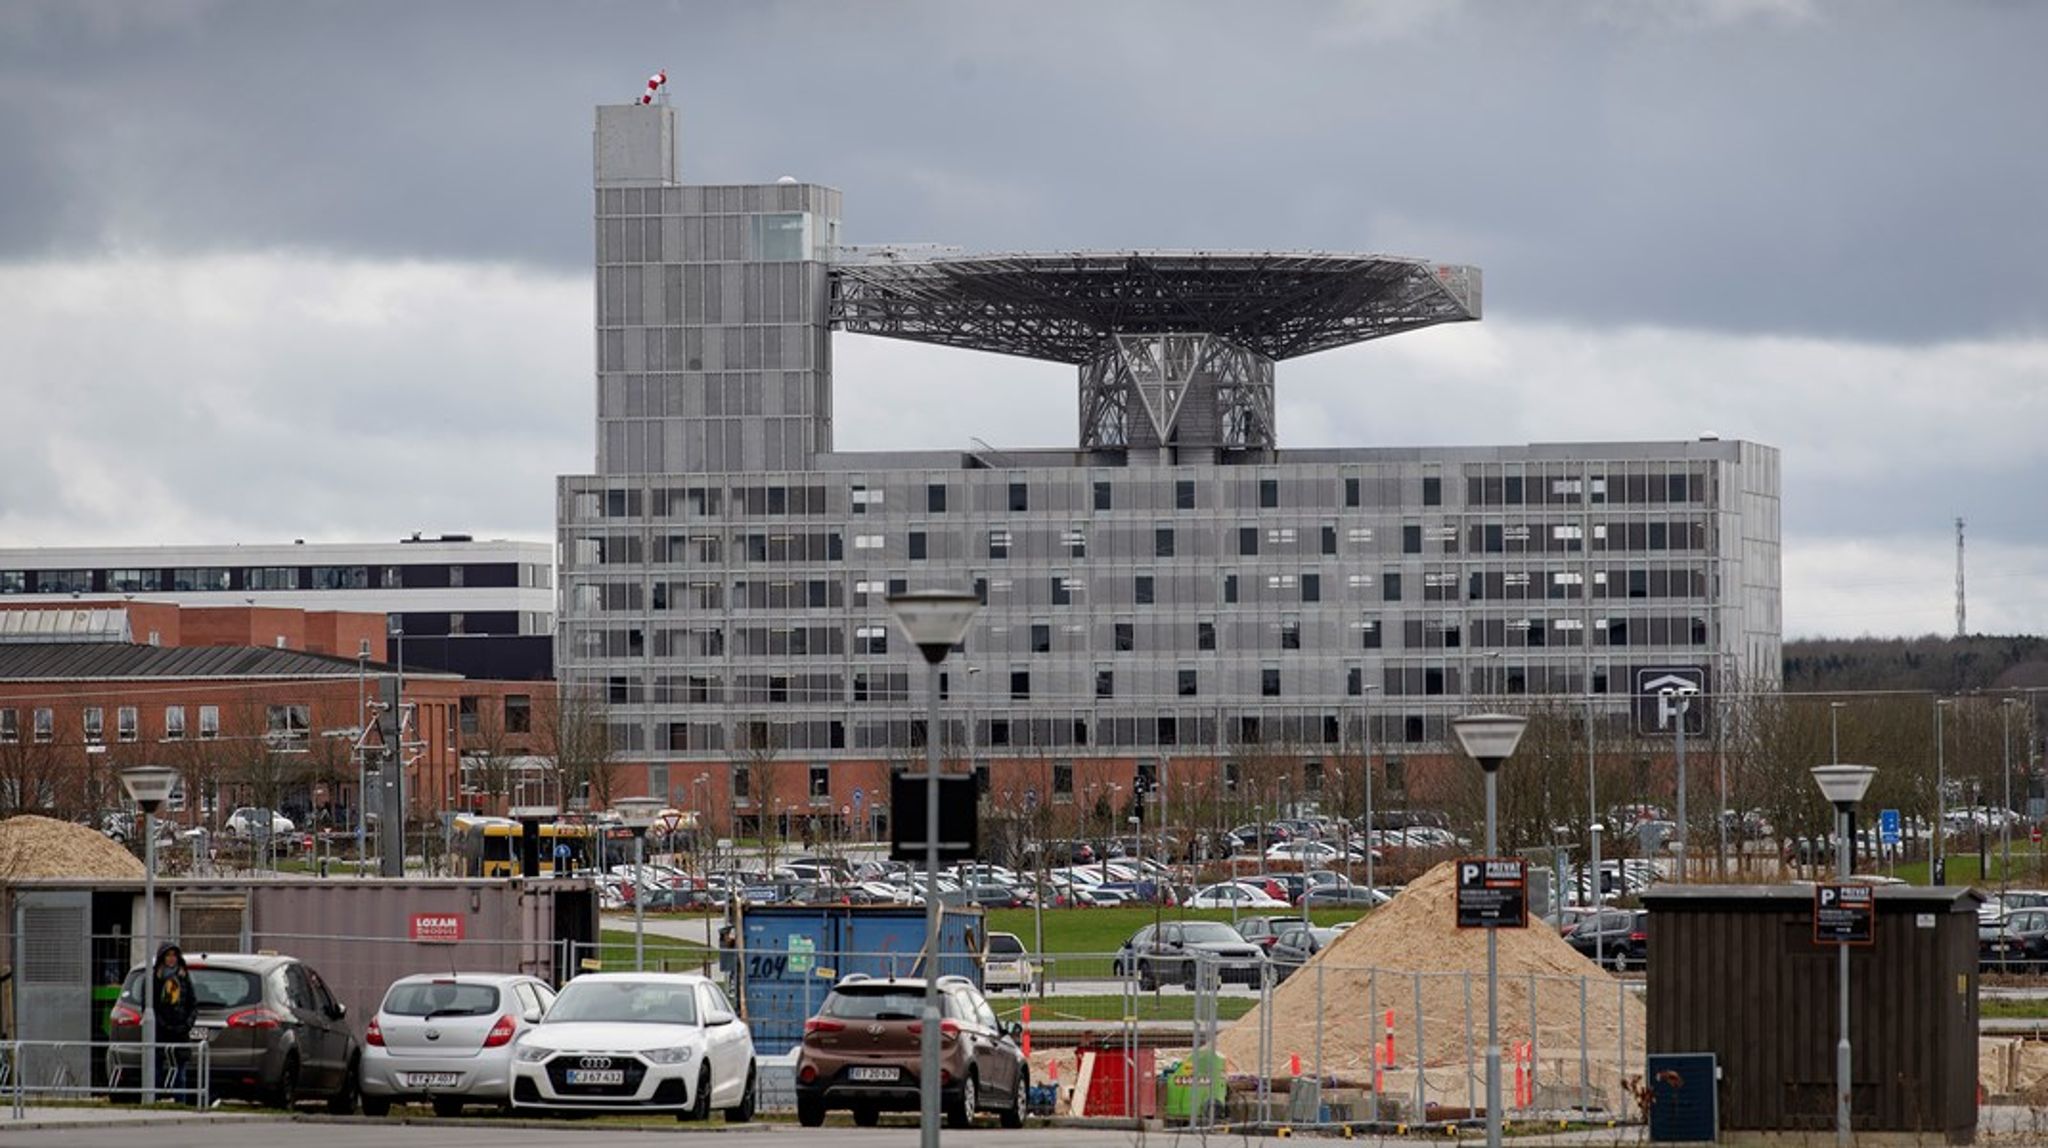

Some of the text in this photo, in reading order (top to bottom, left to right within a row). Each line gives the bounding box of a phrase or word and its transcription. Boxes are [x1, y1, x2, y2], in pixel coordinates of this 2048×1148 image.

[1485, 862, 1521, 873] PRIVAT
[1463, 864, 1479, 885] P
[1821, 889, 1835, 905] P
[1840, 887, 1870, 896] PRIVAT
[416, 918, 457, 927] LOXAM
[747, 955, 788, 980] 104
